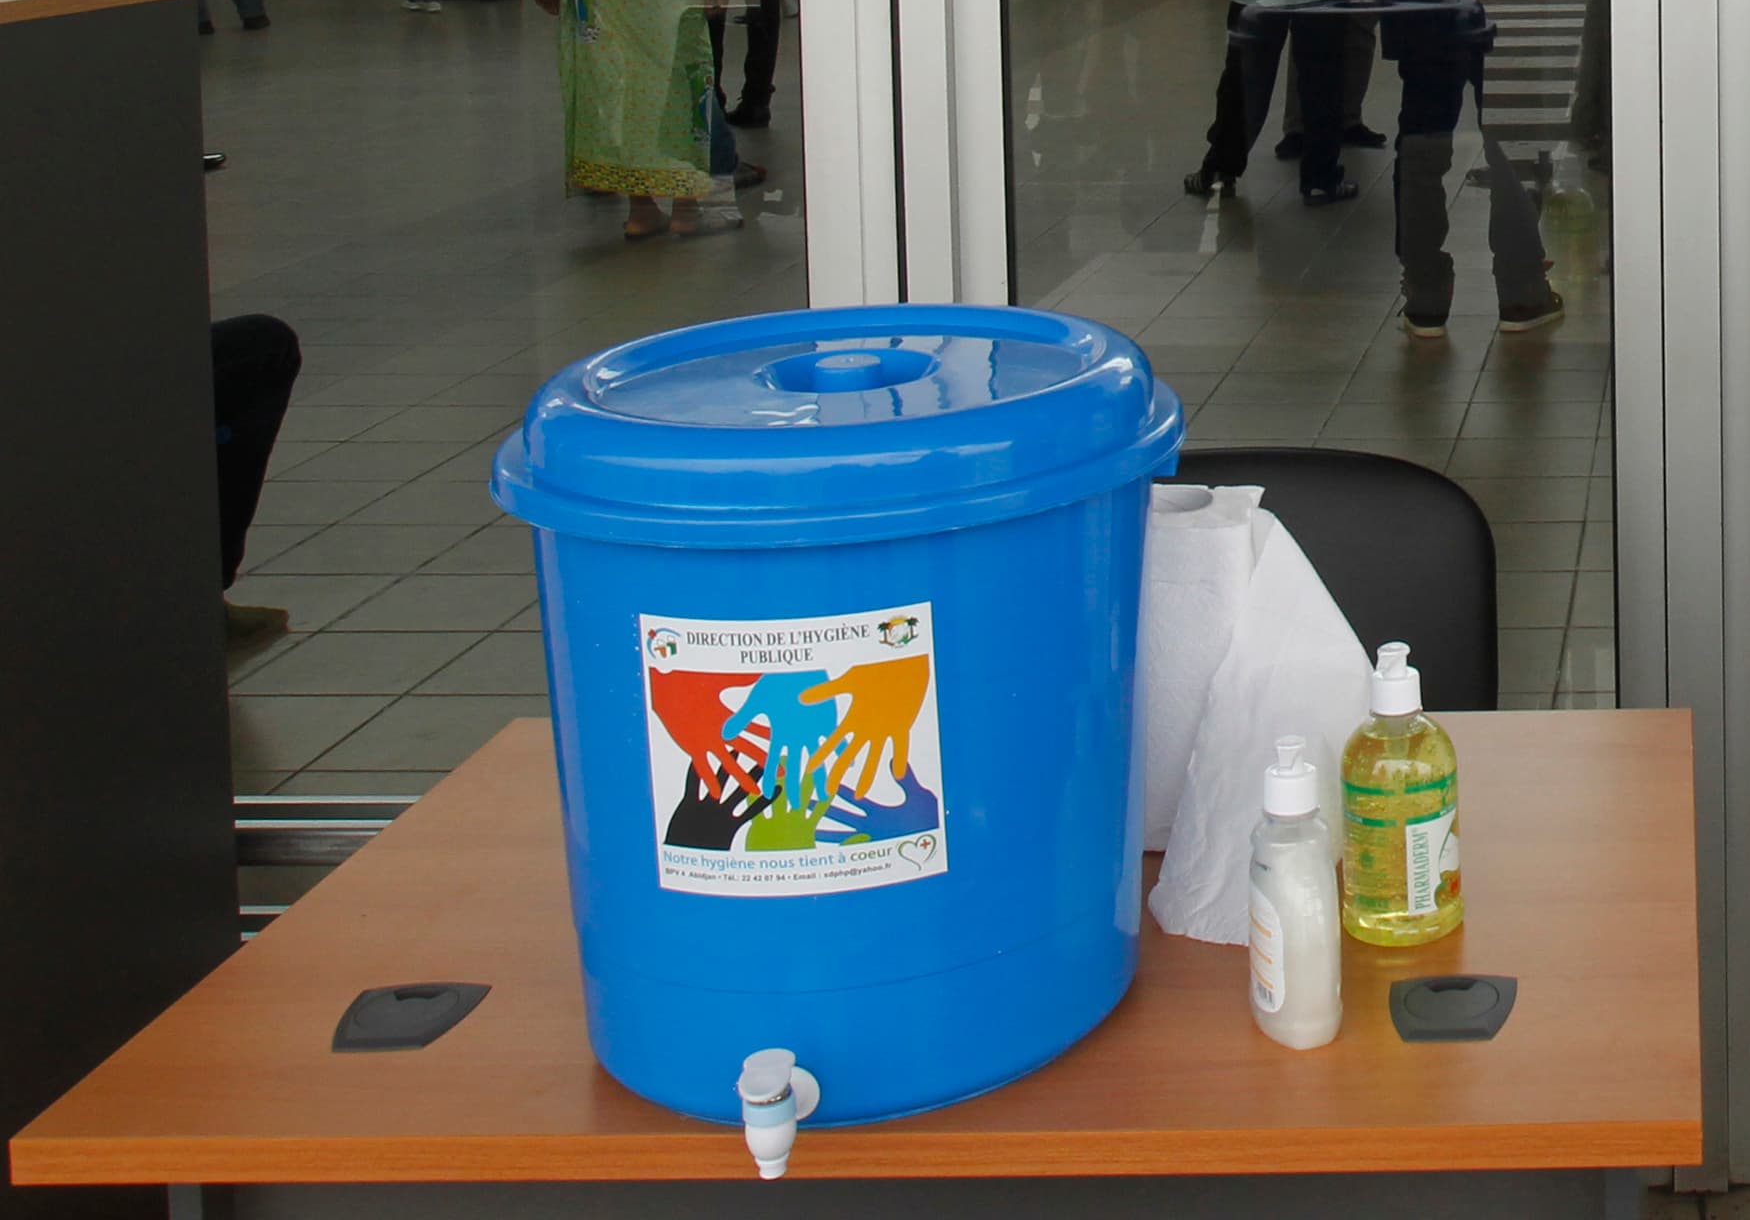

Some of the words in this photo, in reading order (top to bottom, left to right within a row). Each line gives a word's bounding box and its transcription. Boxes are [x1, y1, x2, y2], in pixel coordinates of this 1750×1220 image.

[686, 631, 763, 647] DIRECTION
[766, 632, 786, 646] DE
[790, 623, 870, 645] L'HYGIÈNE
[740, 648, 814, 664] PUBLIQUE
[662, 851, 697, 866] Notre
[700, 857, 755, 872] hygiène
[759, 856, 795, 869] nous
[799, 855, 834, 868] tient
[838, 852, 846, 864] à
[850, 845, 893, 862] coeur
[1411, 831, 1431, 910] PHARMADERM
